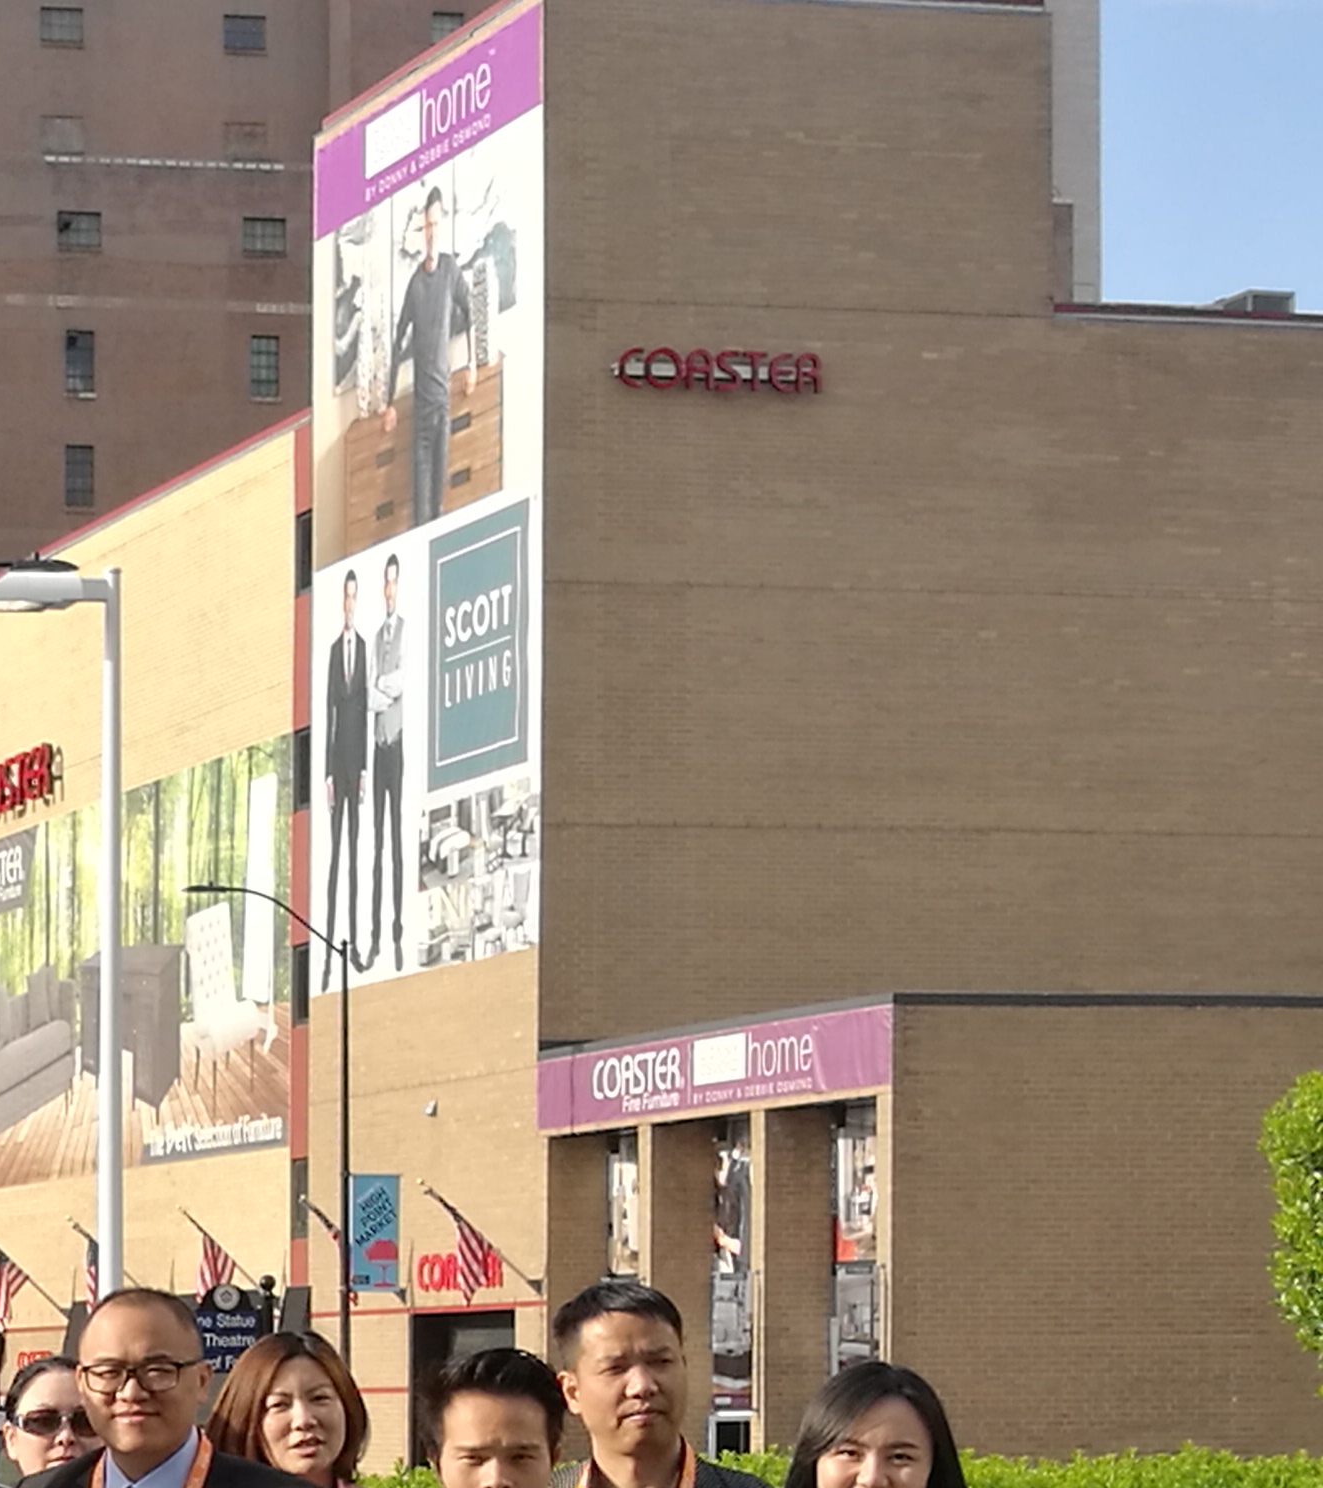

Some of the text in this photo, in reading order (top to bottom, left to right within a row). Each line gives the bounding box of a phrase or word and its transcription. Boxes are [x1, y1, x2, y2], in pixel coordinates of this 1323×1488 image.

[421, 62, 491, 144] home
[618, 346, 821, 394] COASTER
[444, 583, 512, 648] SCOTT
[444, 649, 512, 708] LIVING
[592, 1046, 681, 1101] COASTER
[747, 1032, 813, 1078] home
[358, 1186, 389, 1212] HIGH
[360, 1198, 393, 1228] POINT
[355, 1209, 398, 1247] MARKET
[216, 1312, 257, 1329] Statue
